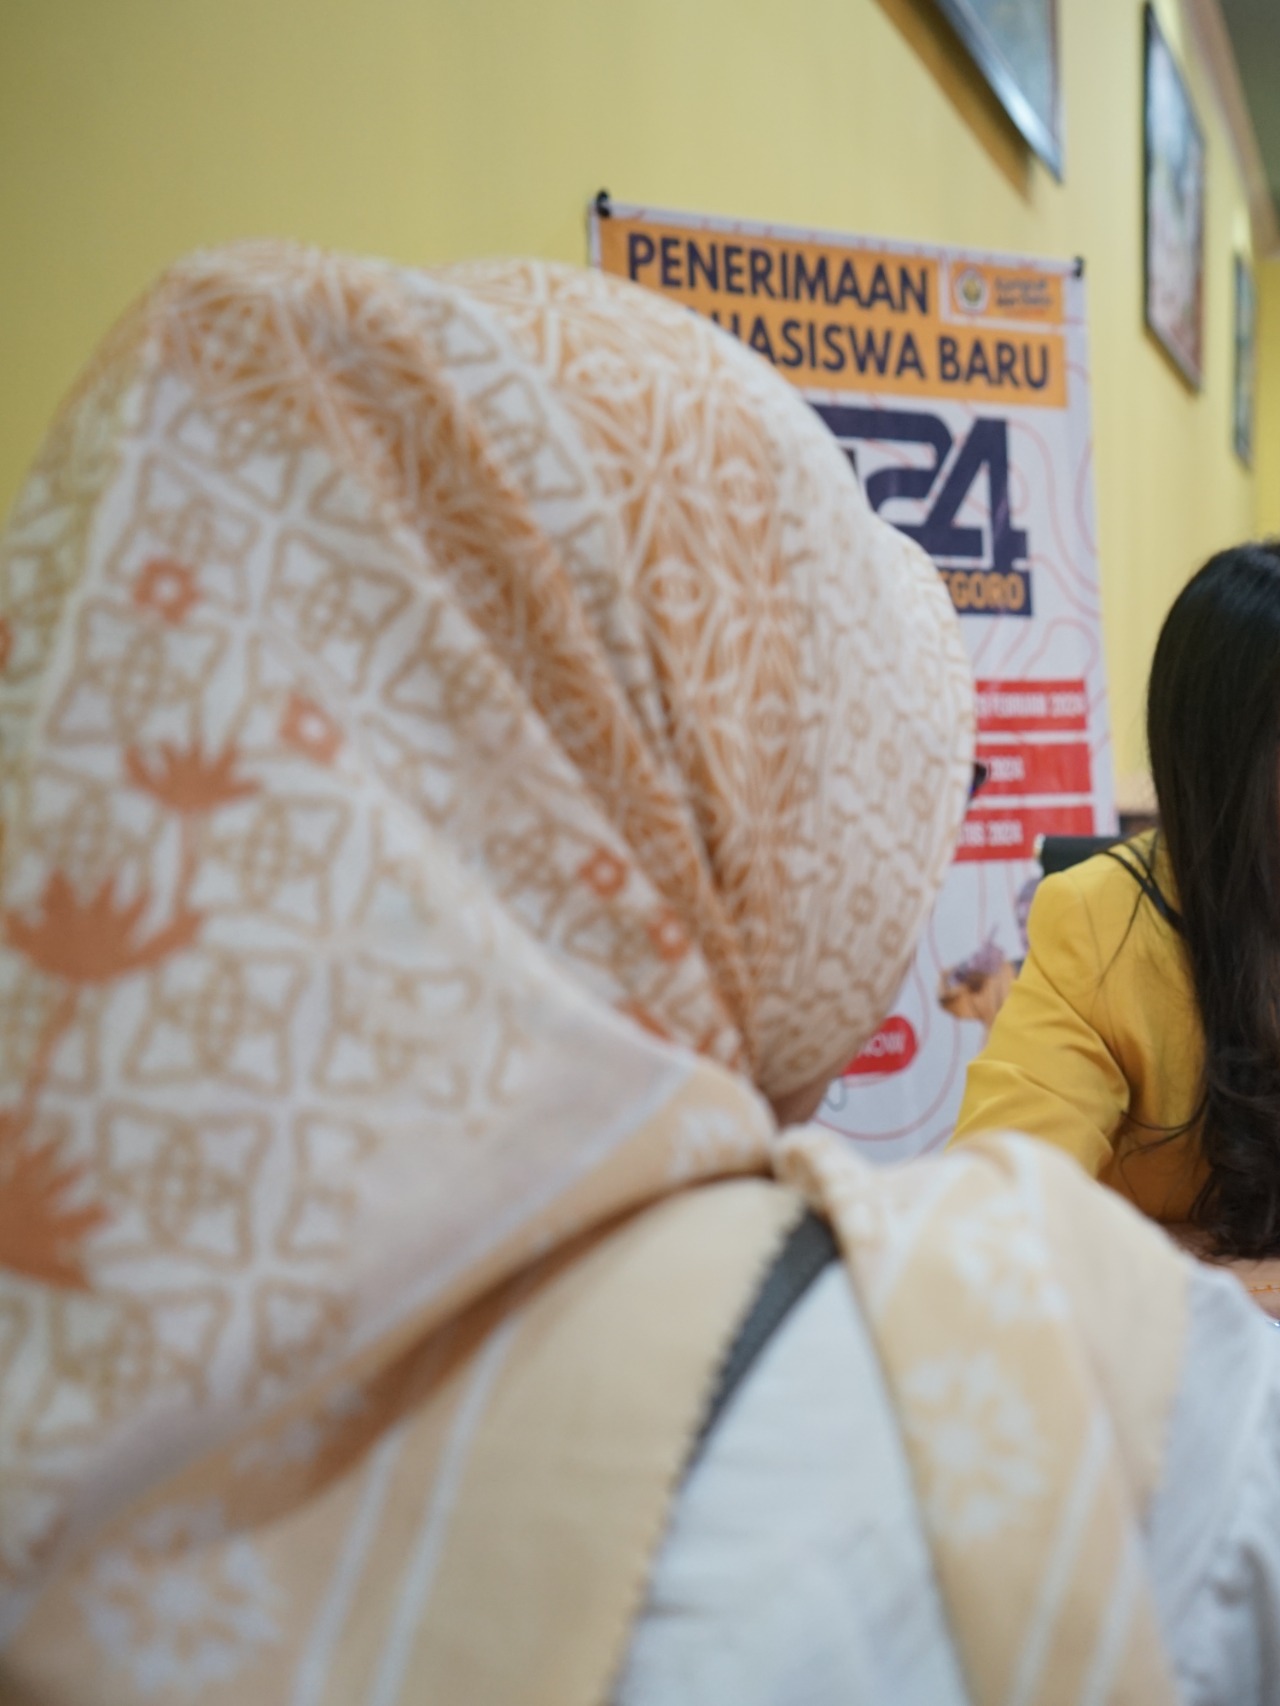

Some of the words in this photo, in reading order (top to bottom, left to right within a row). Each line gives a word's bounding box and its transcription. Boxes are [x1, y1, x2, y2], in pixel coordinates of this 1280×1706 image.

[627, 231, 930, 316] PENERIMAAN
[708, 310, 926, 381] ASISWA
[938, 336, 1049, 391] BARU
[806, 403, 1028, 568] 24
